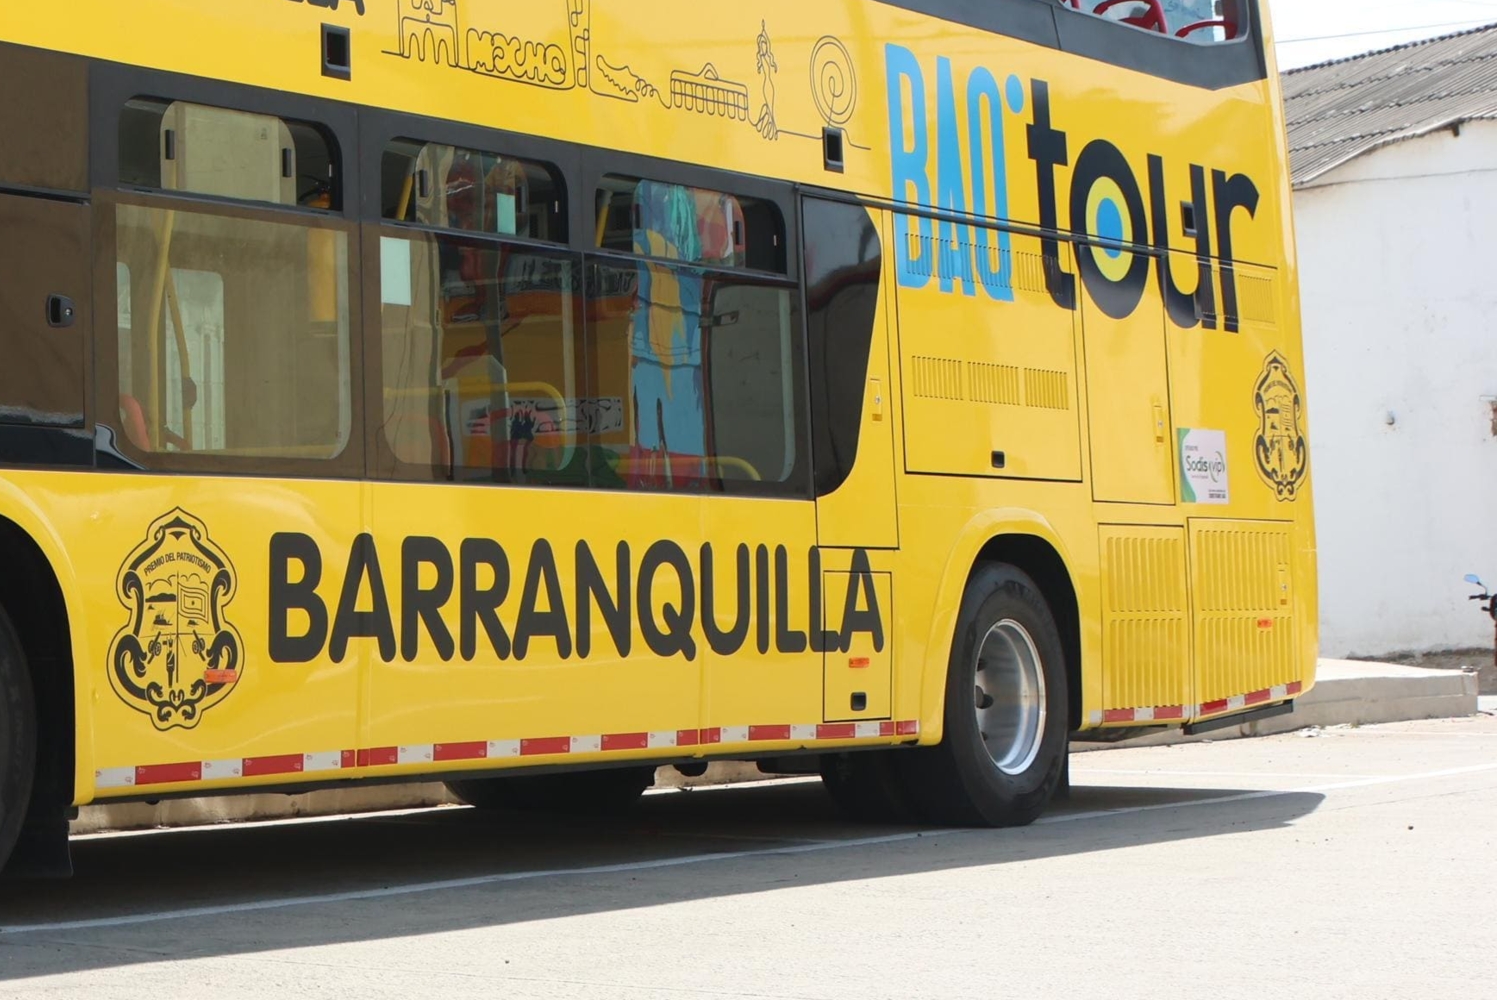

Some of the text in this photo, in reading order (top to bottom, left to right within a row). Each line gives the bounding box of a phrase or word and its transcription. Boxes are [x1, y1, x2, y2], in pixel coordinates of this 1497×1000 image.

[1186, 455, 1208, 472] Sodis
[144, 556, 164, 576] PREMIO
[165, 552, 175, 562] DEL
[268, 531, 884, 663] BARRANQUILLA
